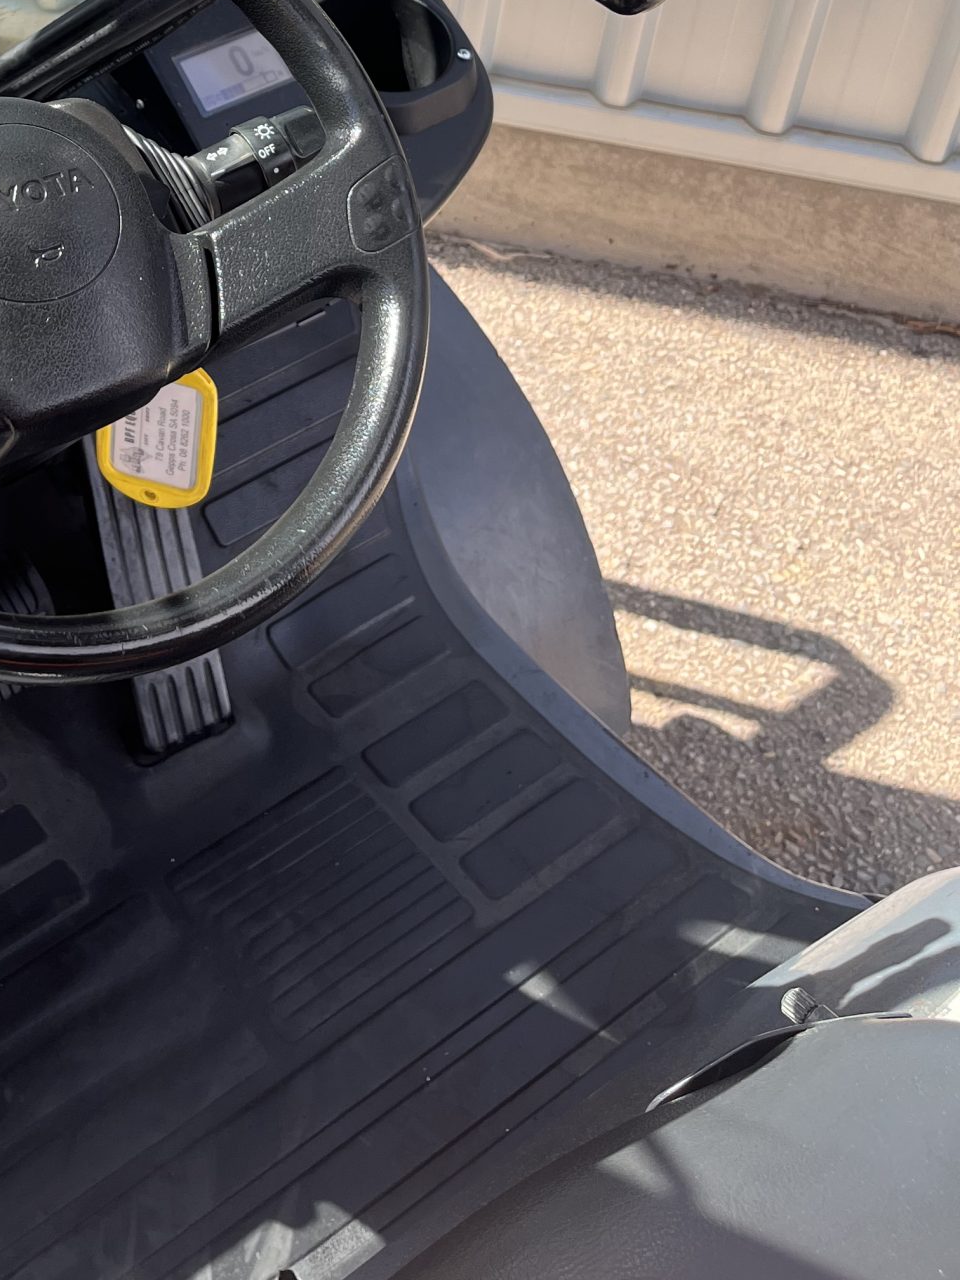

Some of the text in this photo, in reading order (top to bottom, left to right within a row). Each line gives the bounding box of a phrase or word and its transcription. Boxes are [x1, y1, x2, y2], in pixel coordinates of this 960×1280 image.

[257, 143, 277, 160] OFF
[157, 407, 167, 426] Road
[169, 418, 178, 429] SA
[155, 428, 166, 450] Cavan
[167, 430, 177, 450] Cross
